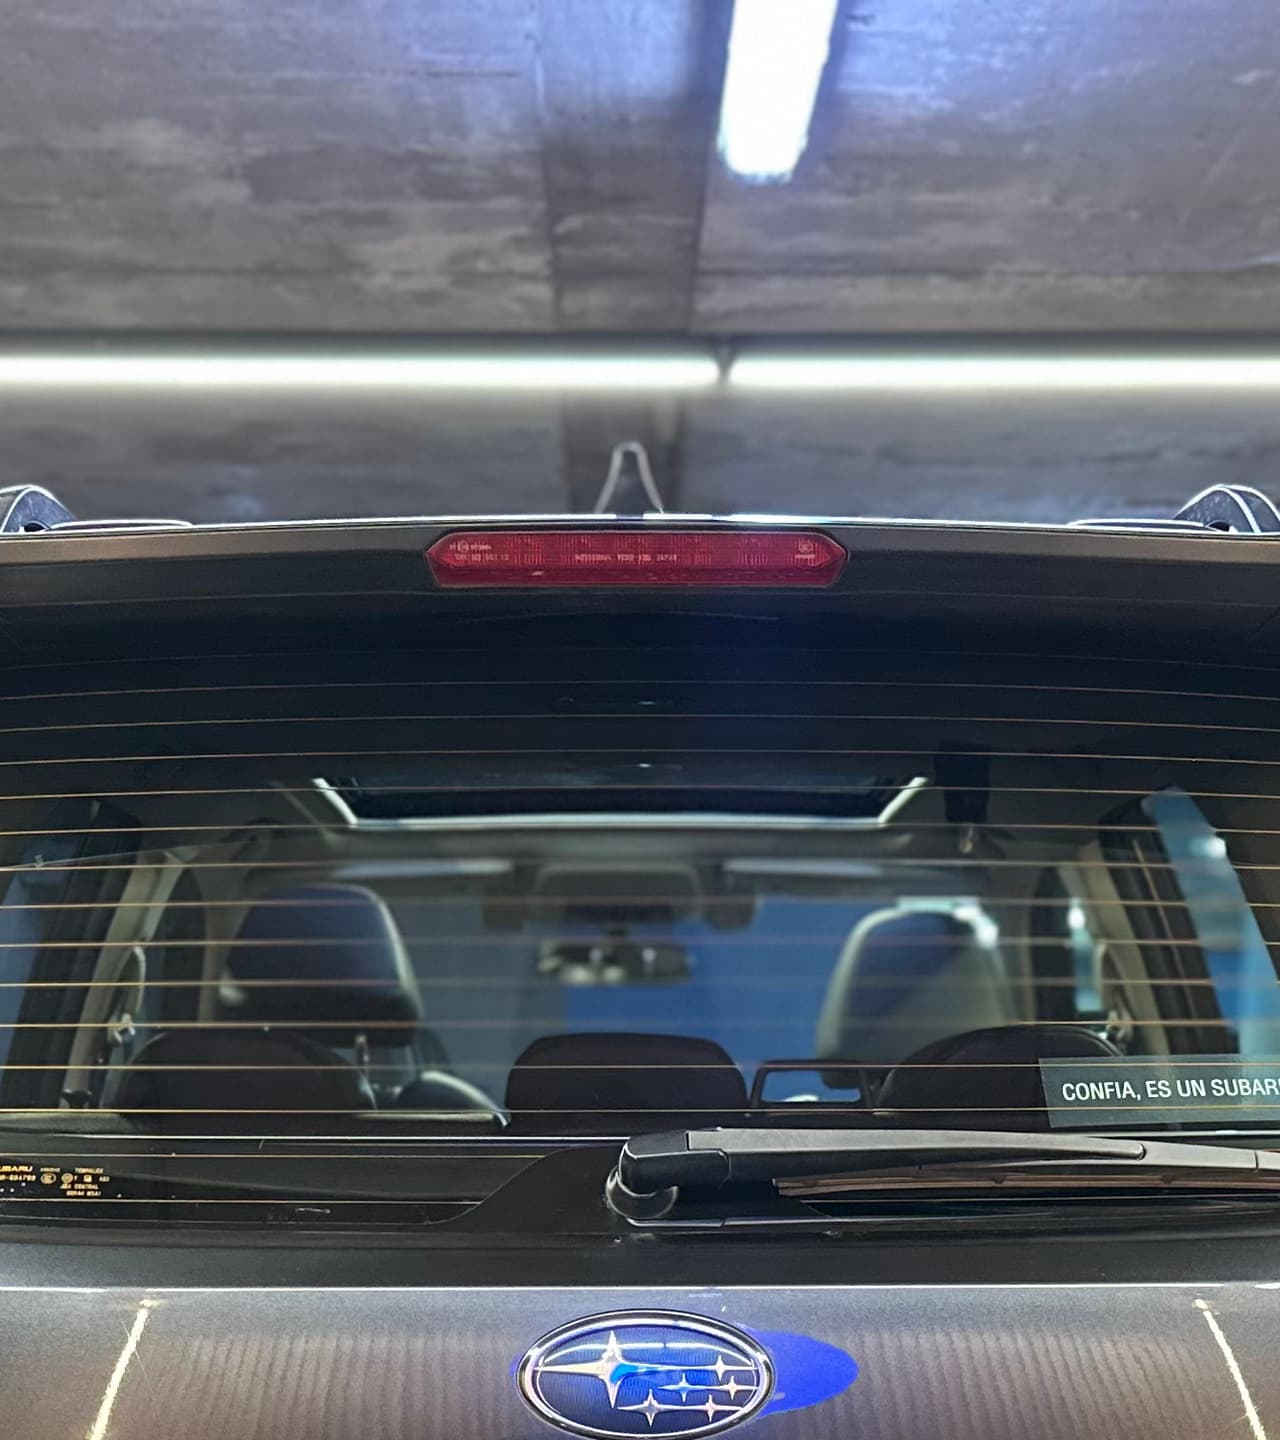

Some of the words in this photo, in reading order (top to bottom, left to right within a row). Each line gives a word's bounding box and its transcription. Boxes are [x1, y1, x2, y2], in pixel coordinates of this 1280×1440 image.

[1061, 1081, 1142, 1101] CONFIA,
[1146, 1079, 1172, 1098] ES
[1176, 1078, 1206, 1098] UN
